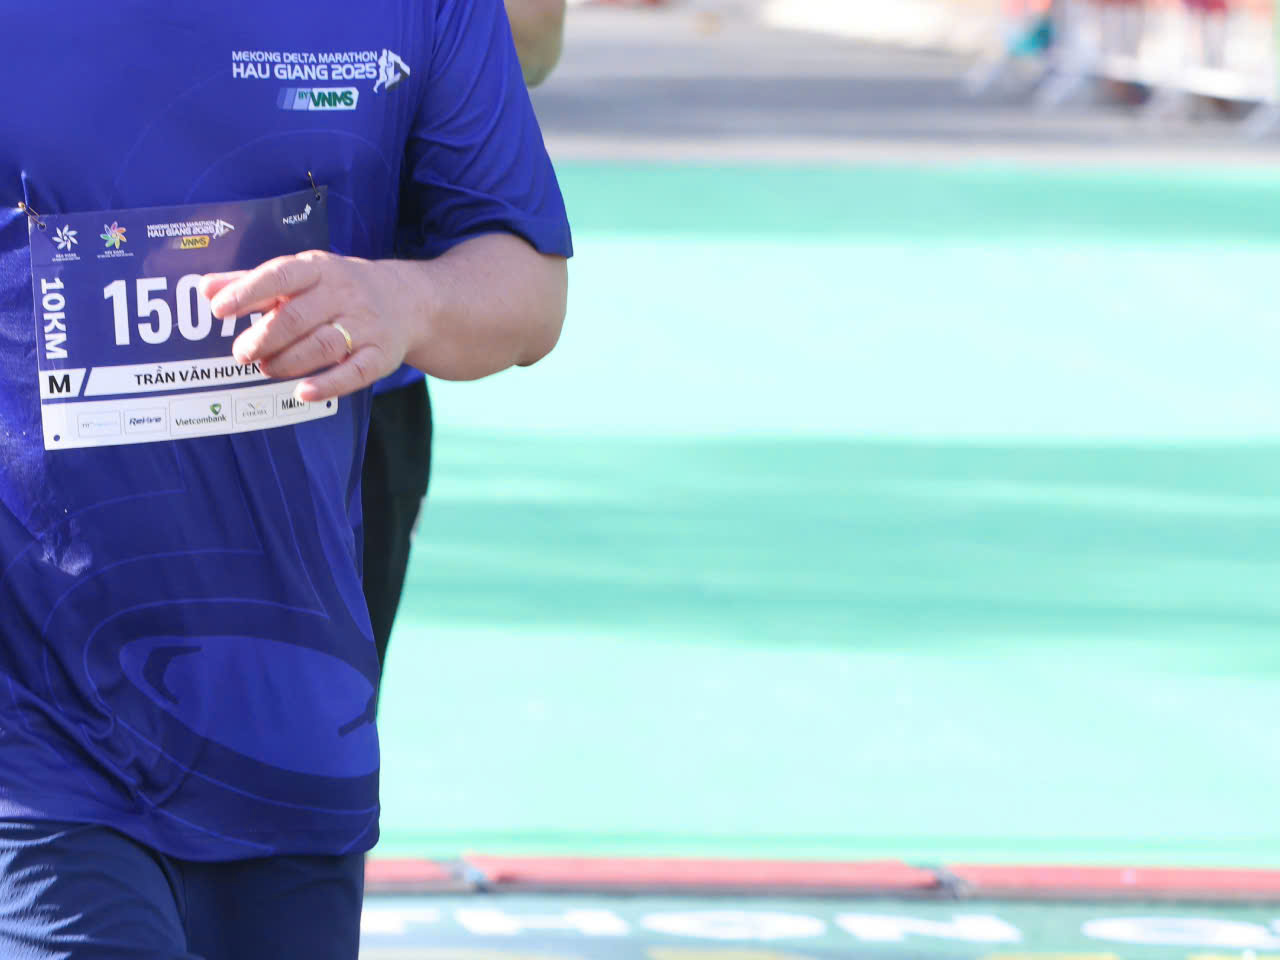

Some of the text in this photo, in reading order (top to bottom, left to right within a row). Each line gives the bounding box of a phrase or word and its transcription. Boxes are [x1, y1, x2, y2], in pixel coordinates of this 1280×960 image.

[232, 50, 378, 64] MEKONG DELTA MARATHON
[232, 63, 378, 80] HAU GIANG 2025
[309, 90, 354, 107] VNMS
[41, 277, 68, 359] 10KM
[103, 274, 263, 345] 150
[49, 374, 71, 394] M
[135, 366, 175, 385] TRẦN
[179, 366, 211, 381] VĂN
[175, 413, 227, 427] Vietcombank
